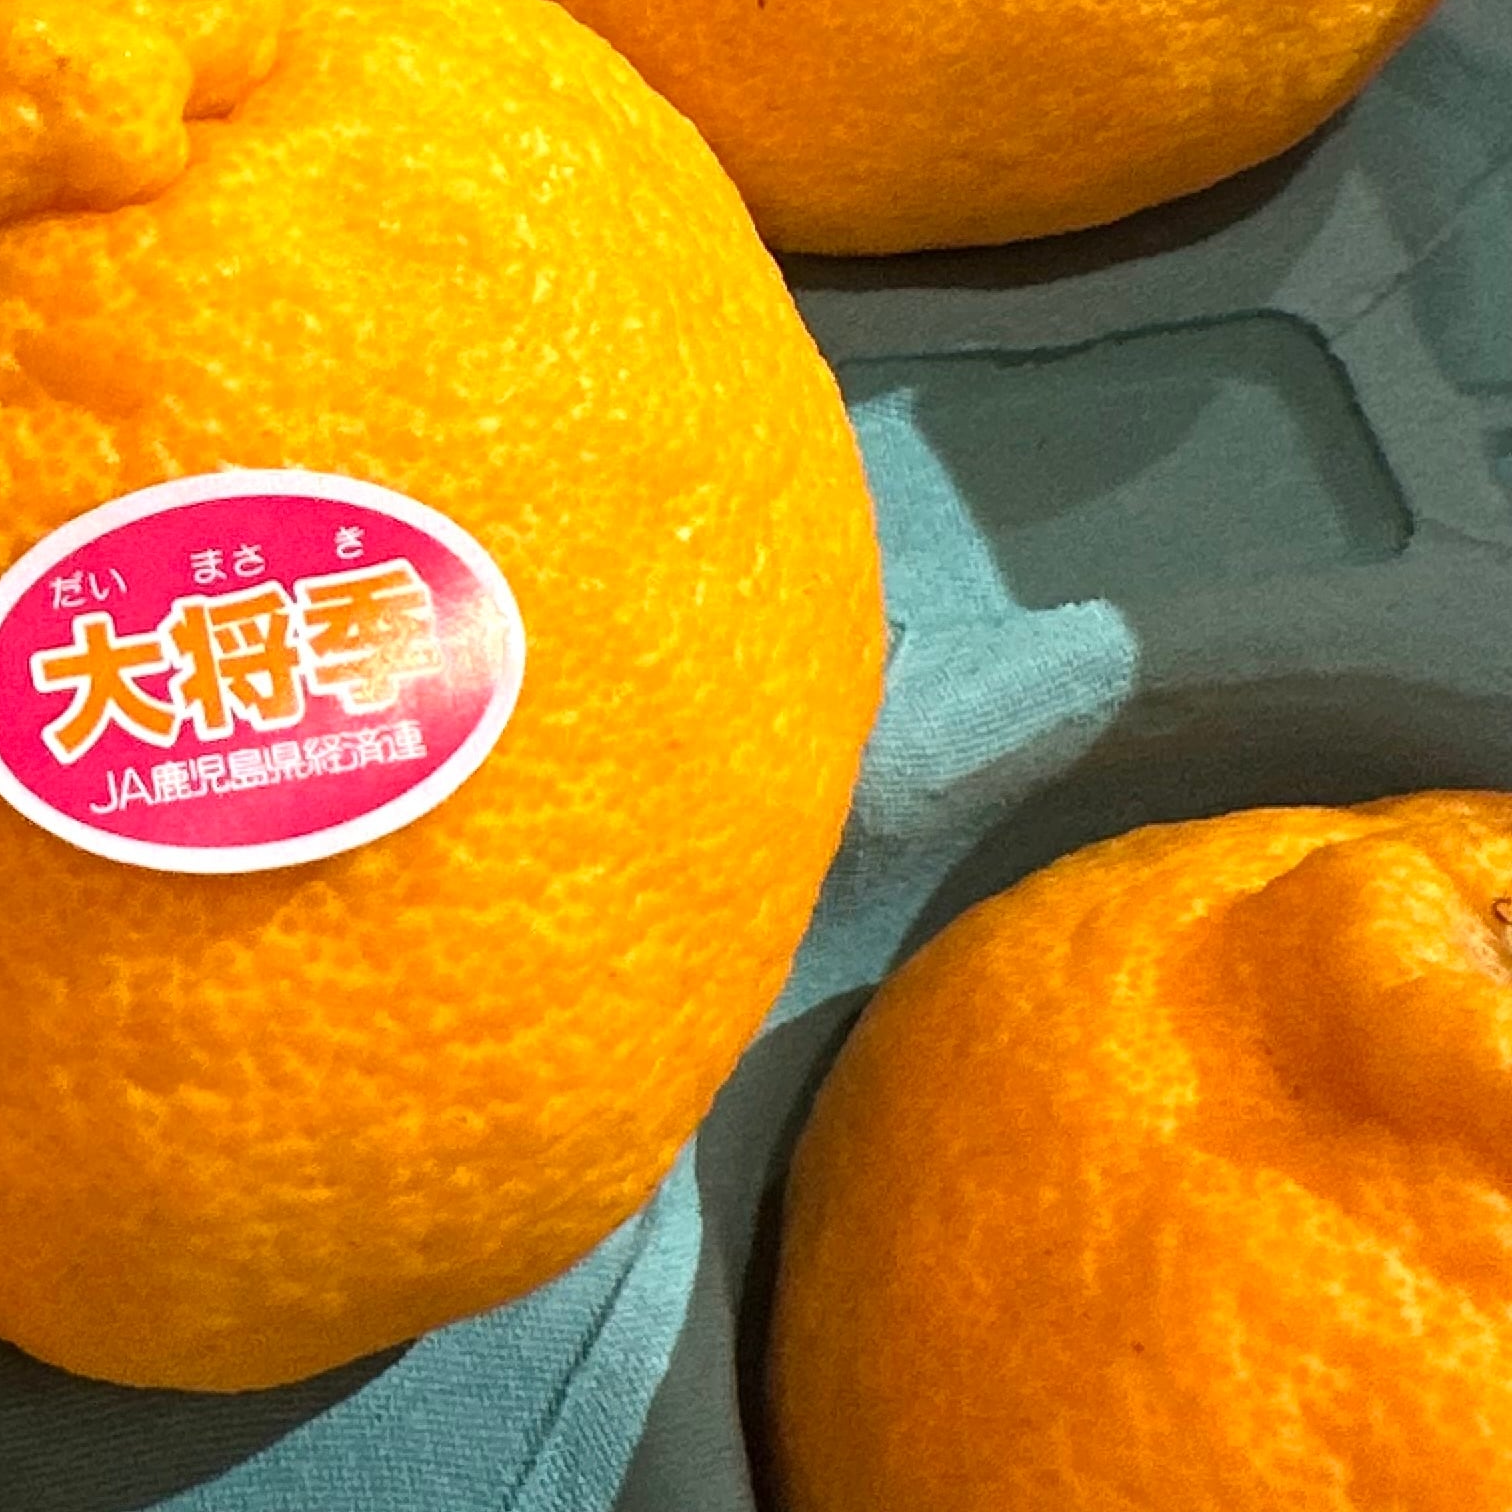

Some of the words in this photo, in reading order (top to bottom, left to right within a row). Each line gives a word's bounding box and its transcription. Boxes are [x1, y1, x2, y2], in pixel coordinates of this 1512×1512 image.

[49, 567, 128, 609] だい
[189, 543, 267, 585] まさ
[334, 525, 366, 560] き
[30, 558, 444, 766] 大将季
[90, 719, 427, 815] JA鹿児島県経済連
